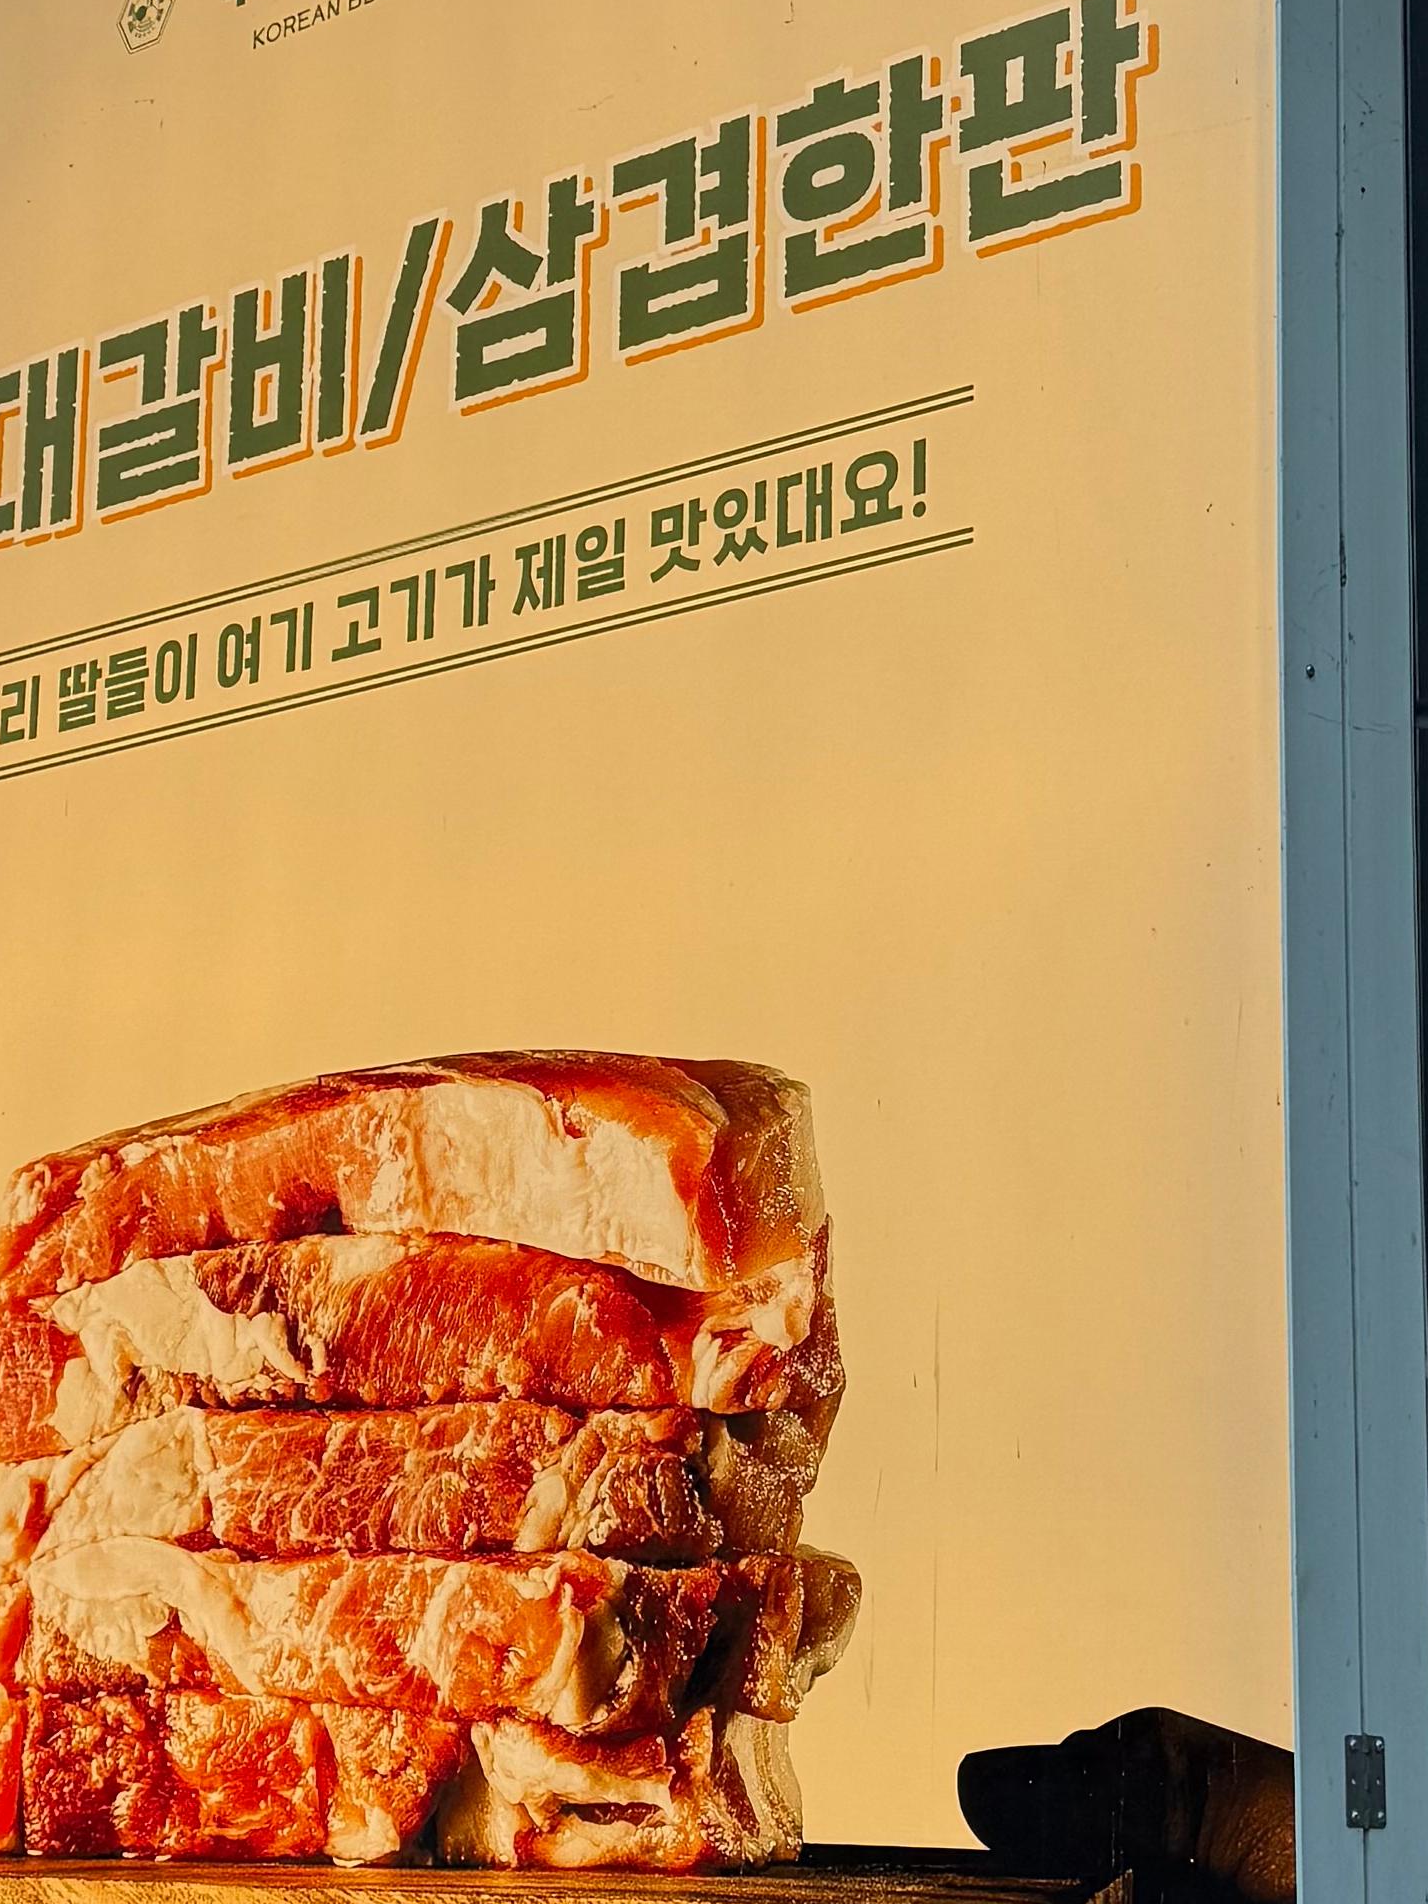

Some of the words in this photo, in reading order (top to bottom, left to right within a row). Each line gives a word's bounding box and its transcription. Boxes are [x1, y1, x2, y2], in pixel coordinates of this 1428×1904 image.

[251, 0, 342, 50] KOREAN
[57, 632, 197, 735] 딸들이
[216, 600, 311, 690] 여기
[333, 551, 496, 665] 고기가
[513, 515, 628, 619] 제일
[649, 435, 930, 584] 맛있대요!
